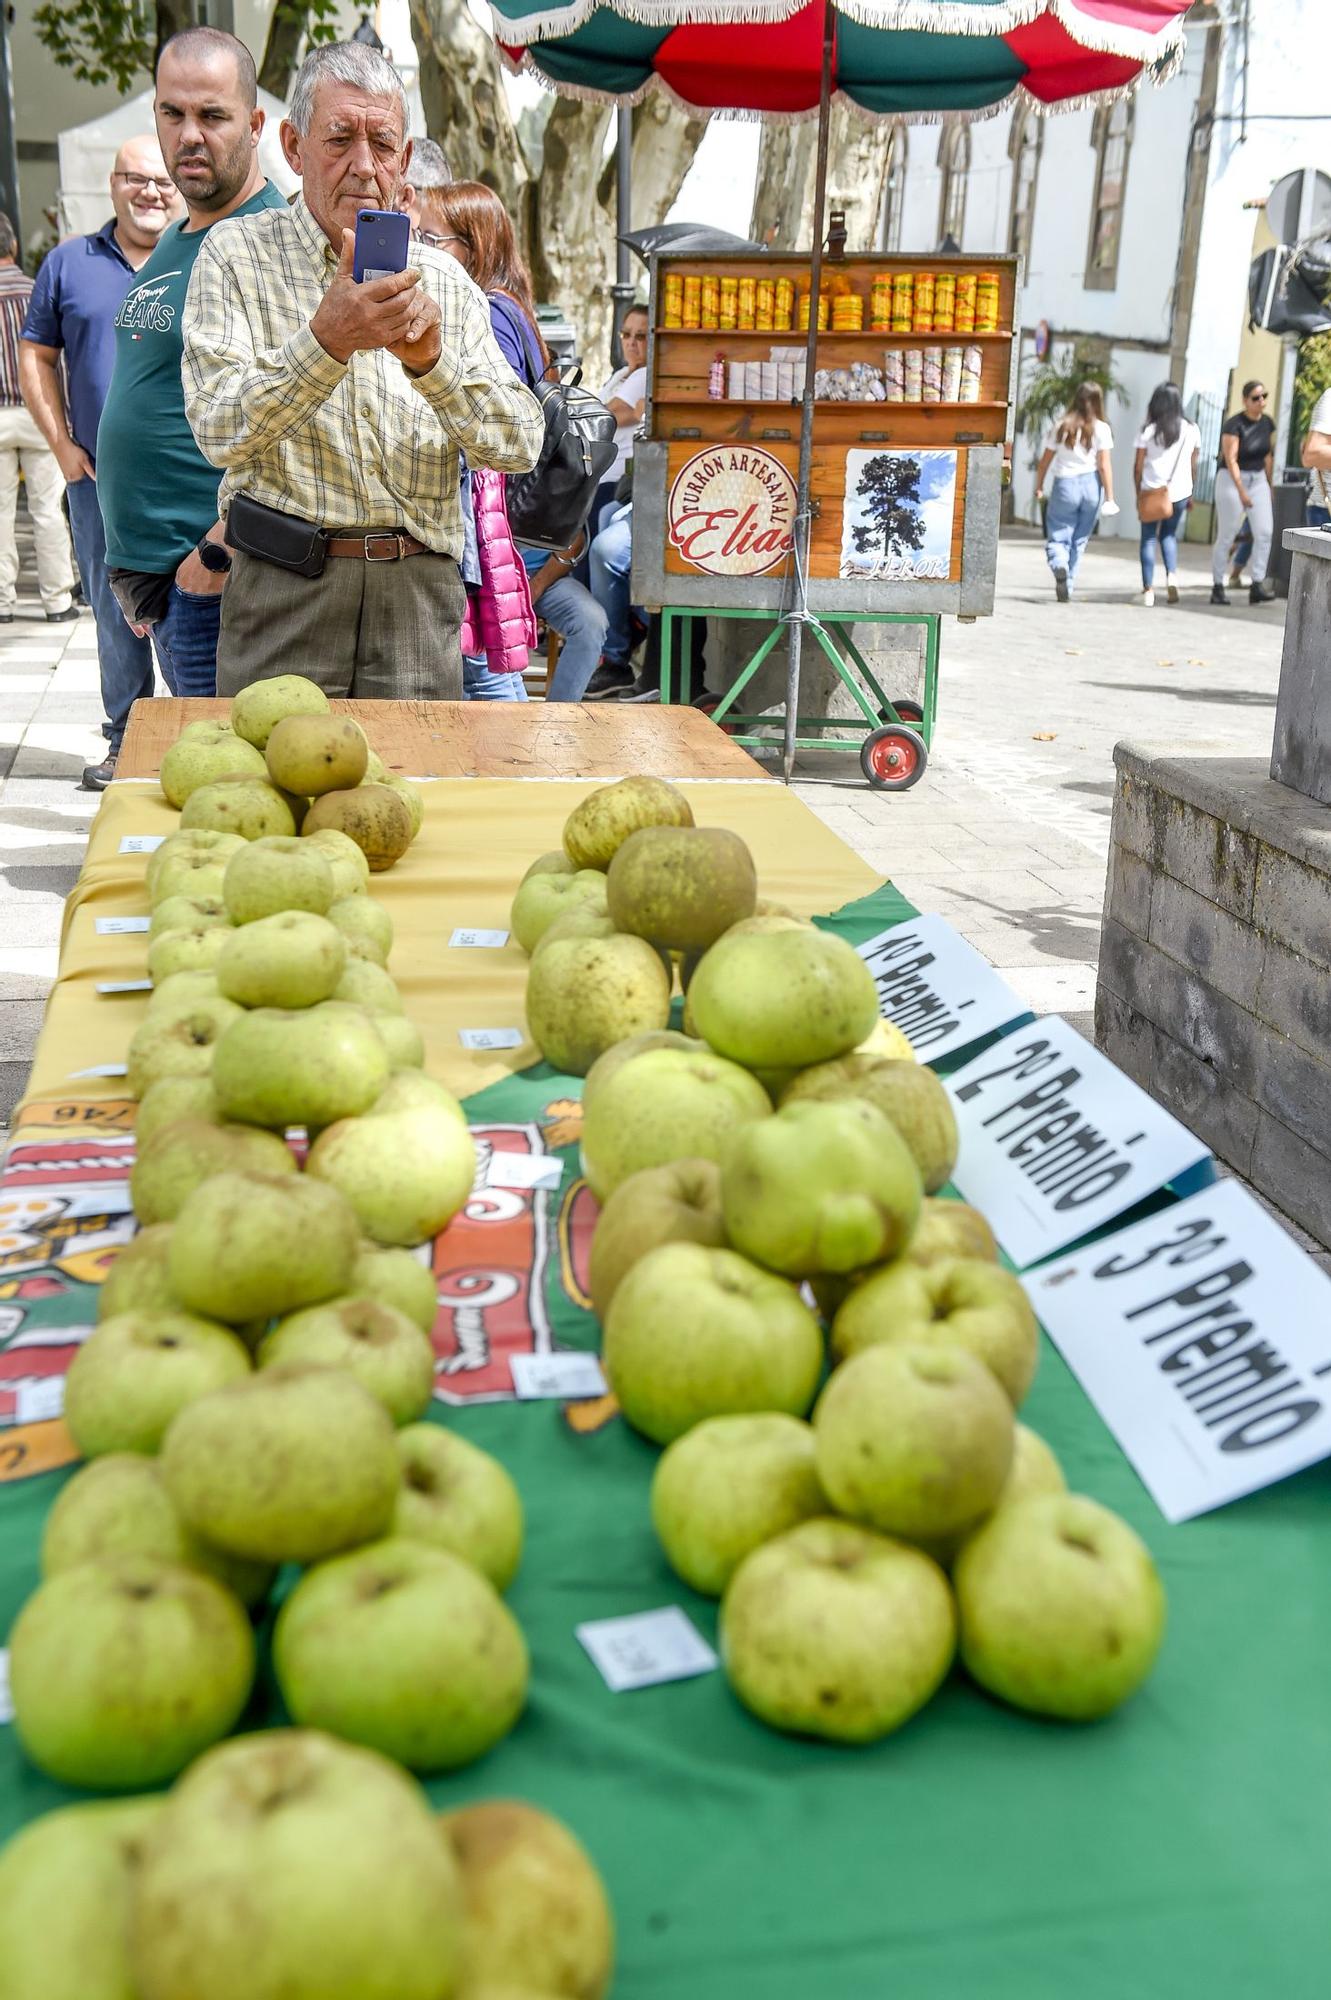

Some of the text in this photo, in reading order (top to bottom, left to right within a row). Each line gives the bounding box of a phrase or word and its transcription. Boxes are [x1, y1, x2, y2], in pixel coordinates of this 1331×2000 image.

[114, 299, 176, 332] JEANS
[683, 454, 789, 524] TURRÓN ARTESANAL
[866, 556, 944, 580] TEROR
[874, 952, 976, 1049] Premio
[982, 1068, 1146, 1211] Premio
[1125, 1259, 1331, 1452] Premio
